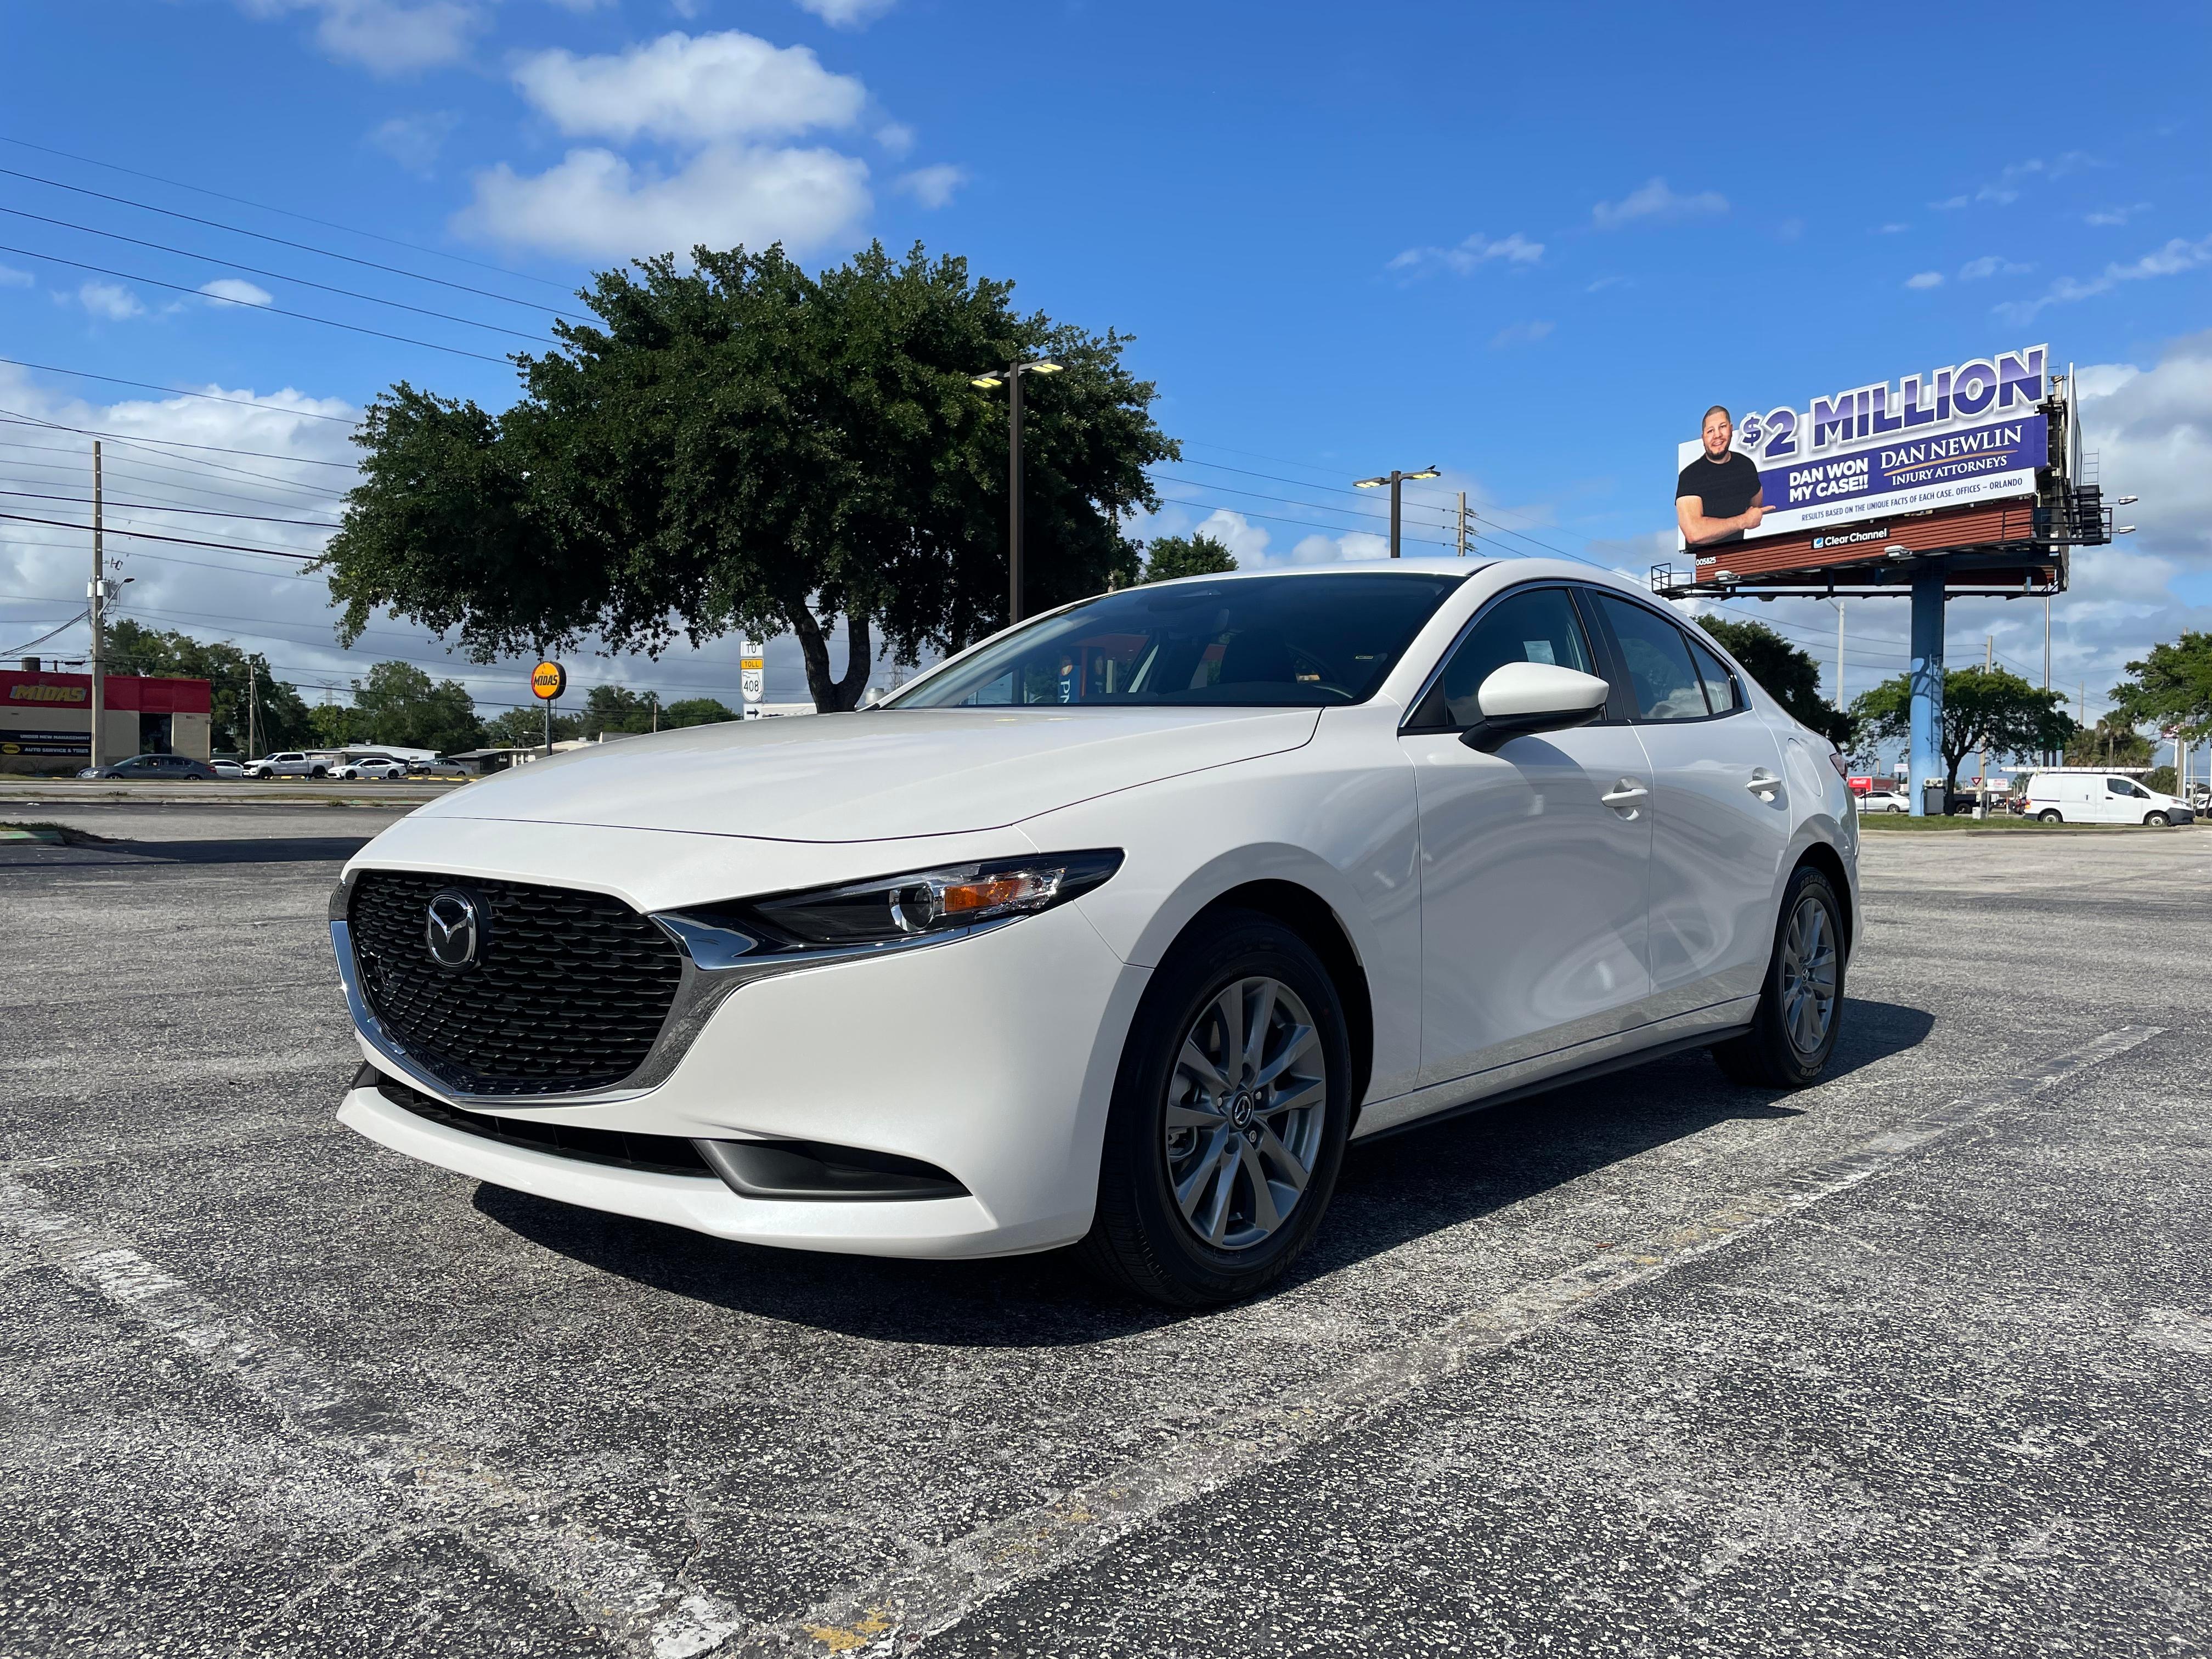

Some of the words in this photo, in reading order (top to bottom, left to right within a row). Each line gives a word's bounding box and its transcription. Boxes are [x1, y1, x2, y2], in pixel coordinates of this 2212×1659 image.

[1739, 408, 1798, 461] $2
[1812, 345, 2046, 450] MILLION
[1880, 444, 1926, 469] DAN
[1930, 425, 2023, 459] NEWLIN
[1790, 466, 1823, 487] DAN
[1826, 458, 1869, 479] WON
[1893, 469, 1934, 486] INJURY
[1935, 455, 2007, 478] ATTORNEYS
[1790, 485, 1814, 503] MY
[1816, 474, 1869, 497] CASE!!
[1802, 511, 1824, 521] RESULTS
[1825, 507, 1843, 517] BASED
[1867, 500, 1889, 510] UNIQUE
[1891, 497, 1908, 506] FACTS
[1919, 492, 1934, 501] EACH
[1936, 489, 1954, 499] CASE.
[1956, 484, 1980, 495] OFFICES
[1989, 478, 2022, 489] ORLANDO
[1825, 535, 1849, 546] Clear
[1849, 528, 1887, 542] Channel
[1696, 556, 1716, 566] 005825
[746, 644, 757, 653] TO
[534, 675, 558, 687] MIDAS
[744, 680, 759, 692] 408
[15, 685, 84, 702] MIDAS
